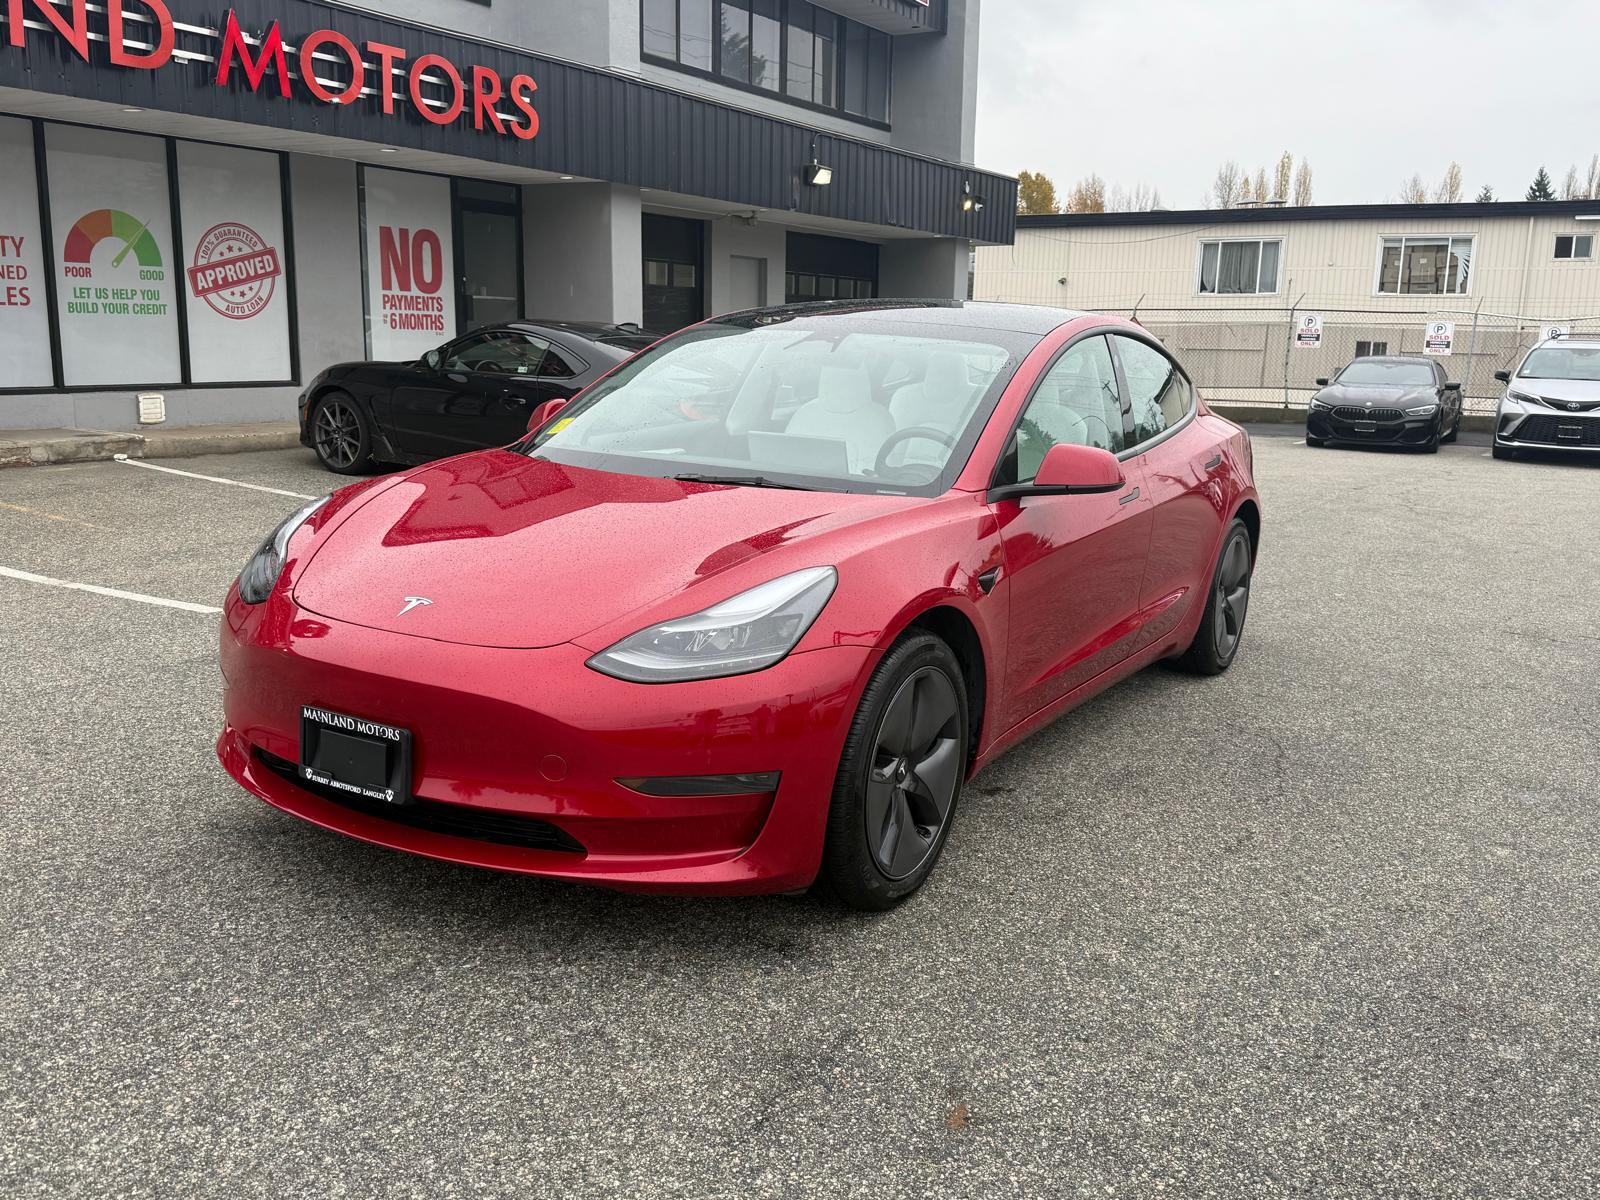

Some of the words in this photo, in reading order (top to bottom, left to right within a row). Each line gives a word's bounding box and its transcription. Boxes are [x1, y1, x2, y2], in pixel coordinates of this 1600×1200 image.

[214, 8, 539, 140] MOTORS
[201, 239, 215, 259] 100%
[213, 228, 258, 248] GUARANTEED
[379, 226, 443, 294] NO
[64, 266, 92, 278] POOR
[139, 269, 165, 281] GOOD
[196, 254, 274, 290] APPROVED
[73, 287, 92, 299] LET
[95, 287, 109, 300] US
[112, 288, 137, 300] HELP
[140, 289, 160, 301] YOU
[382, 294, 444, 312] PAYMENTS
[67, 301, 99, 314] BUILD
[101, 302, 130, 315] YOUR
[132, 303, 167, 315] CREDIT
[225, 304, 245, 314] AUTO
[247, 295, 264, 312] LOAN
[390, 312, 398, 330] 6
[399, 313, 445, 331] MONTHS
[303, 707, 355, 730] MAINLAND
[357, 722, 400, 741] MOTORS
[312, 775, 329, 785] SURREY
[330, 780, 362, 794] ABBOTSFORD
[363, 788, 386, 800] LANGLEY
